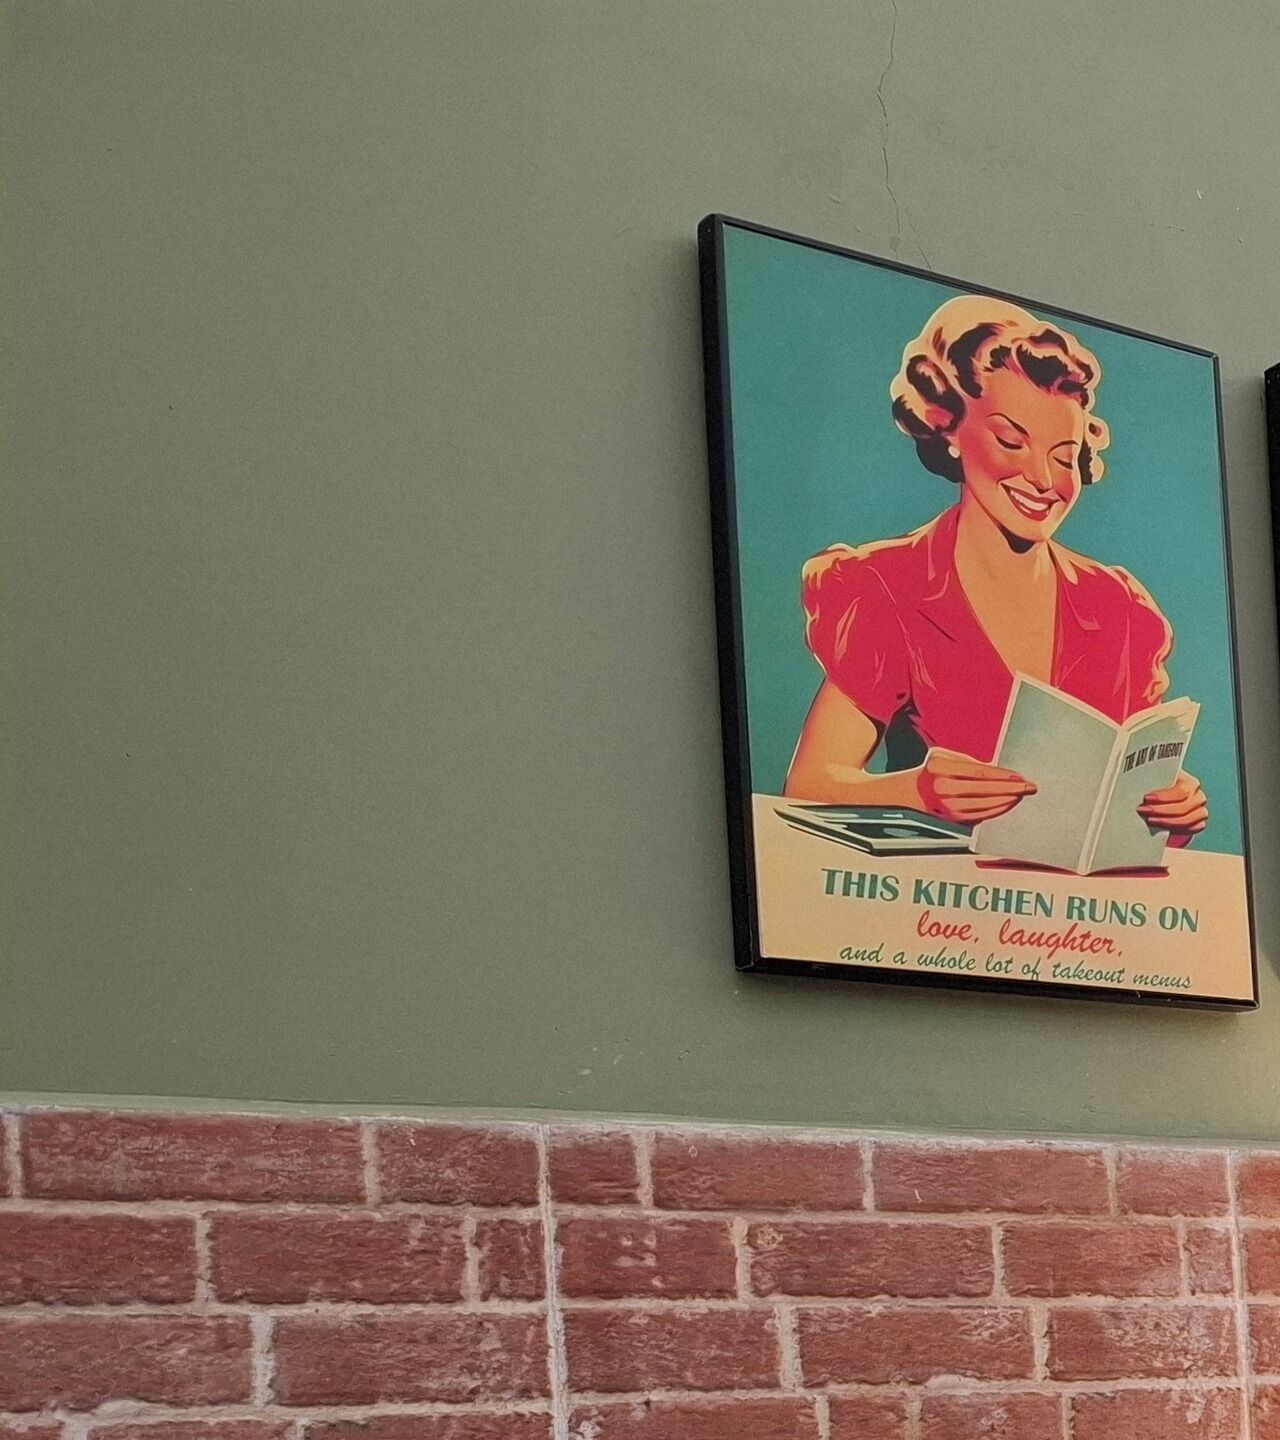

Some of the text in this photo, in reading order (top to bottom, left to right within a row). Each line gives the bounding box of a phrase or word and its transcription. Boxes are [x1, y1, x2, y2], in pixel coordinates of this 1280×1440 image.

[821, 868, 1200, 932] THIS KITCHEN RUNS ON
[840, 943, 1193, 990] and a whole lot of takeout menus
